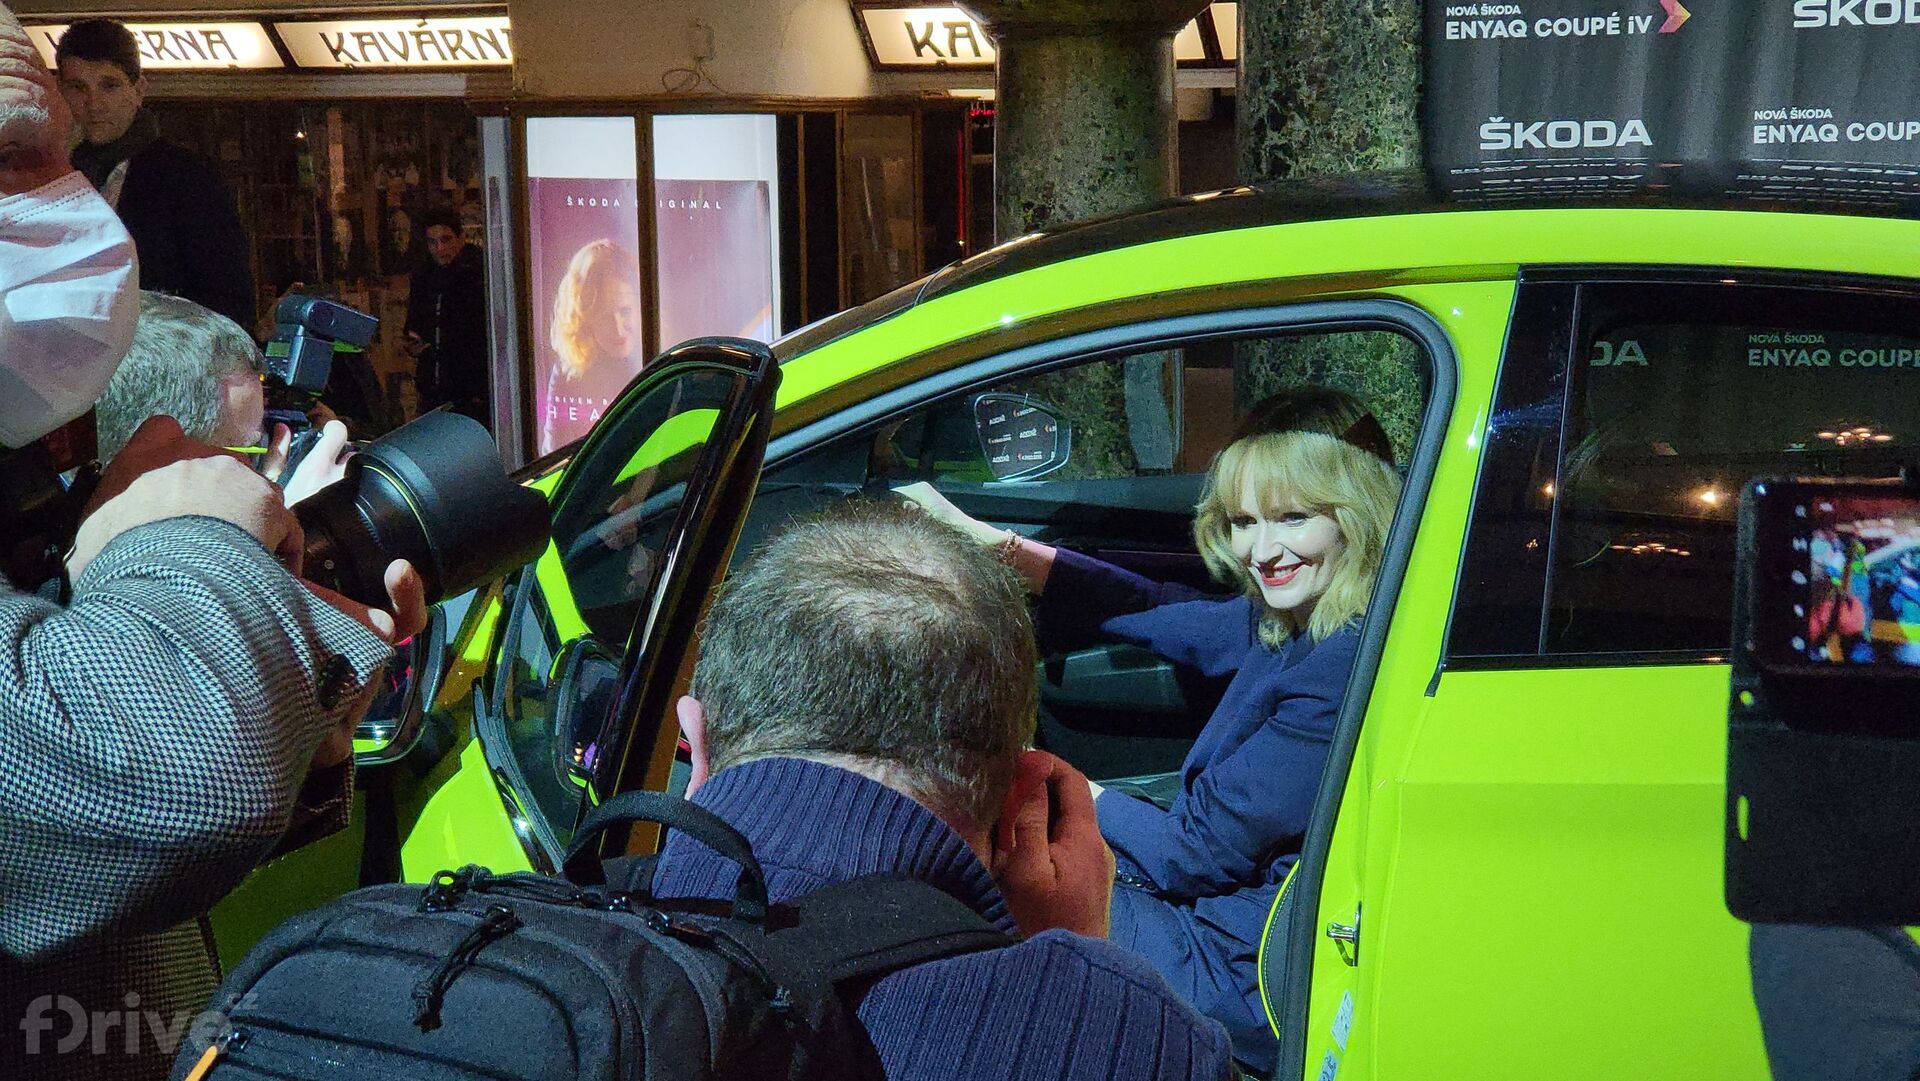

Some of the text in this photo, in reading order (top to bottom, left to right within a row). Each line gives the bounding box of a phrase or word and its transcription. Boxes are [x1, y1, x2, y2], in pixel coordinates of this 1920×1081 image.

[1446, 4, 1521, 17] NOVÁ ŠKODA
[1446, 12, 1652, 39] ENYAQ COUPÉ iV
[1754, 107, 1833, 120] NOVÁ ŠKODA
[1480, 116, 1654, 150] ŠKODA
[1753, 124, 1839, 143] ENYAQ
[566, 194, 621, 207] ŠKODA
[1748, 349, 1831, 367] ENYAQ
